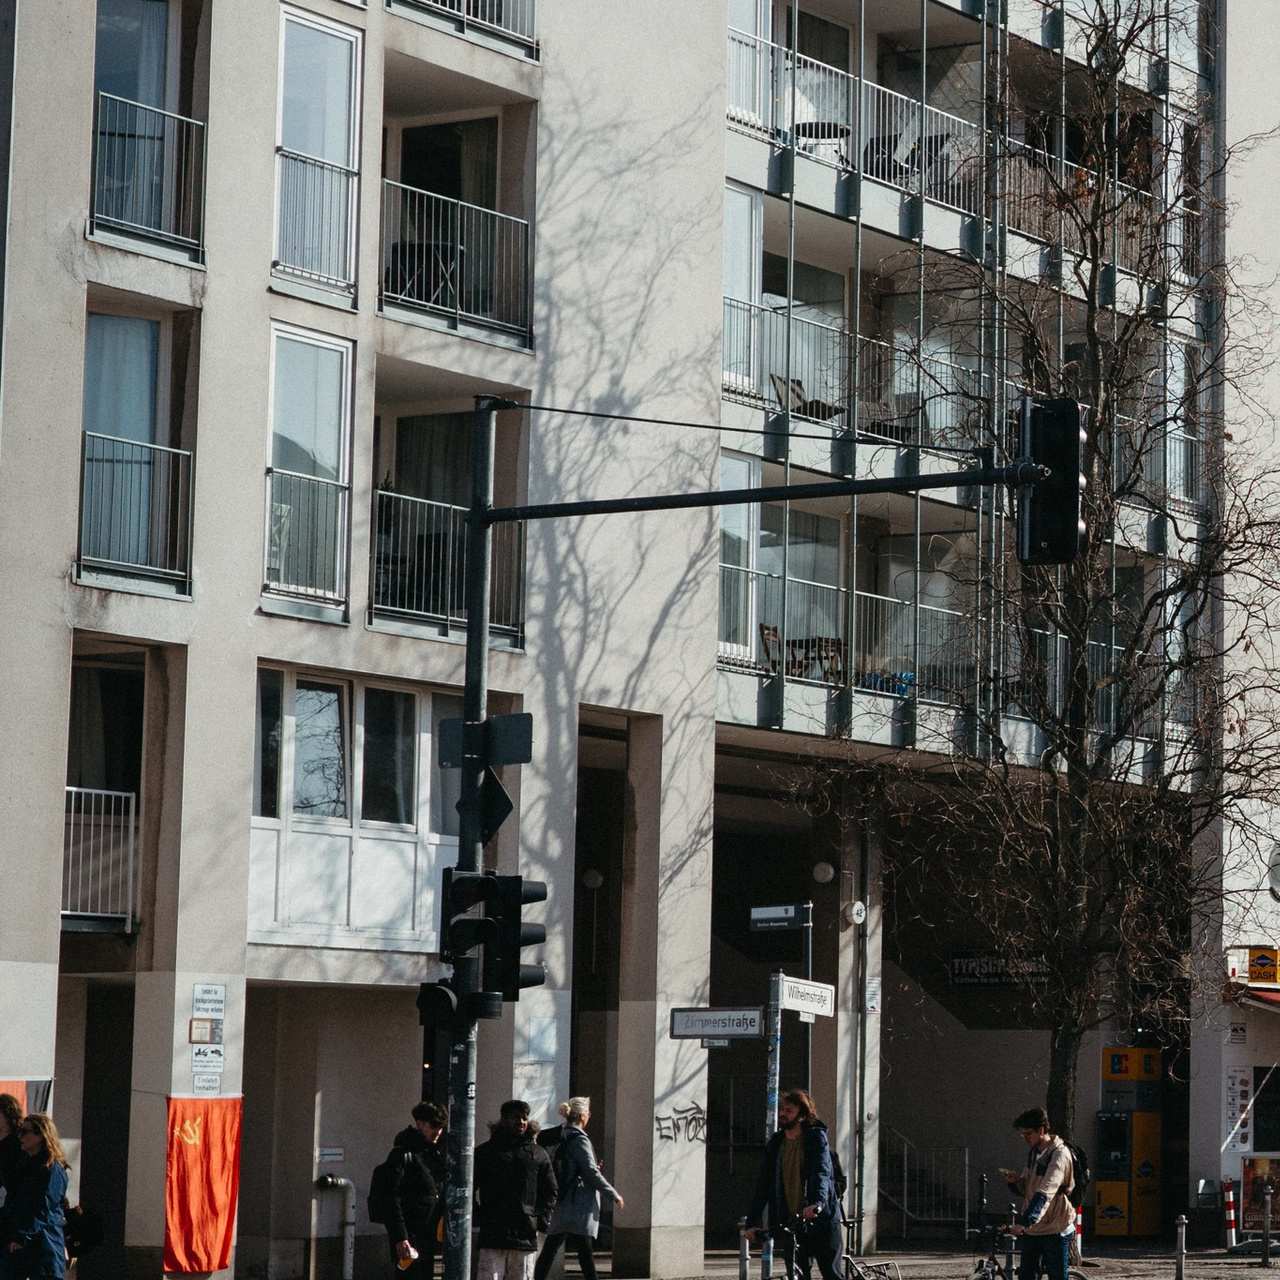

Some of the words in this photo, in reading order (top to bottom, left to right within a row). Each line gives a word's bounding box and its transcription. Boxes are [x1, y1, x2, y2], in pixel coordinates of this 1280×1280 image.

[1250, 971, 1276, 980] CASH
[787, 984, 828, 1008] Wilhelmstraße
[684, 1014, 756, 1031] Zimmerstraße
